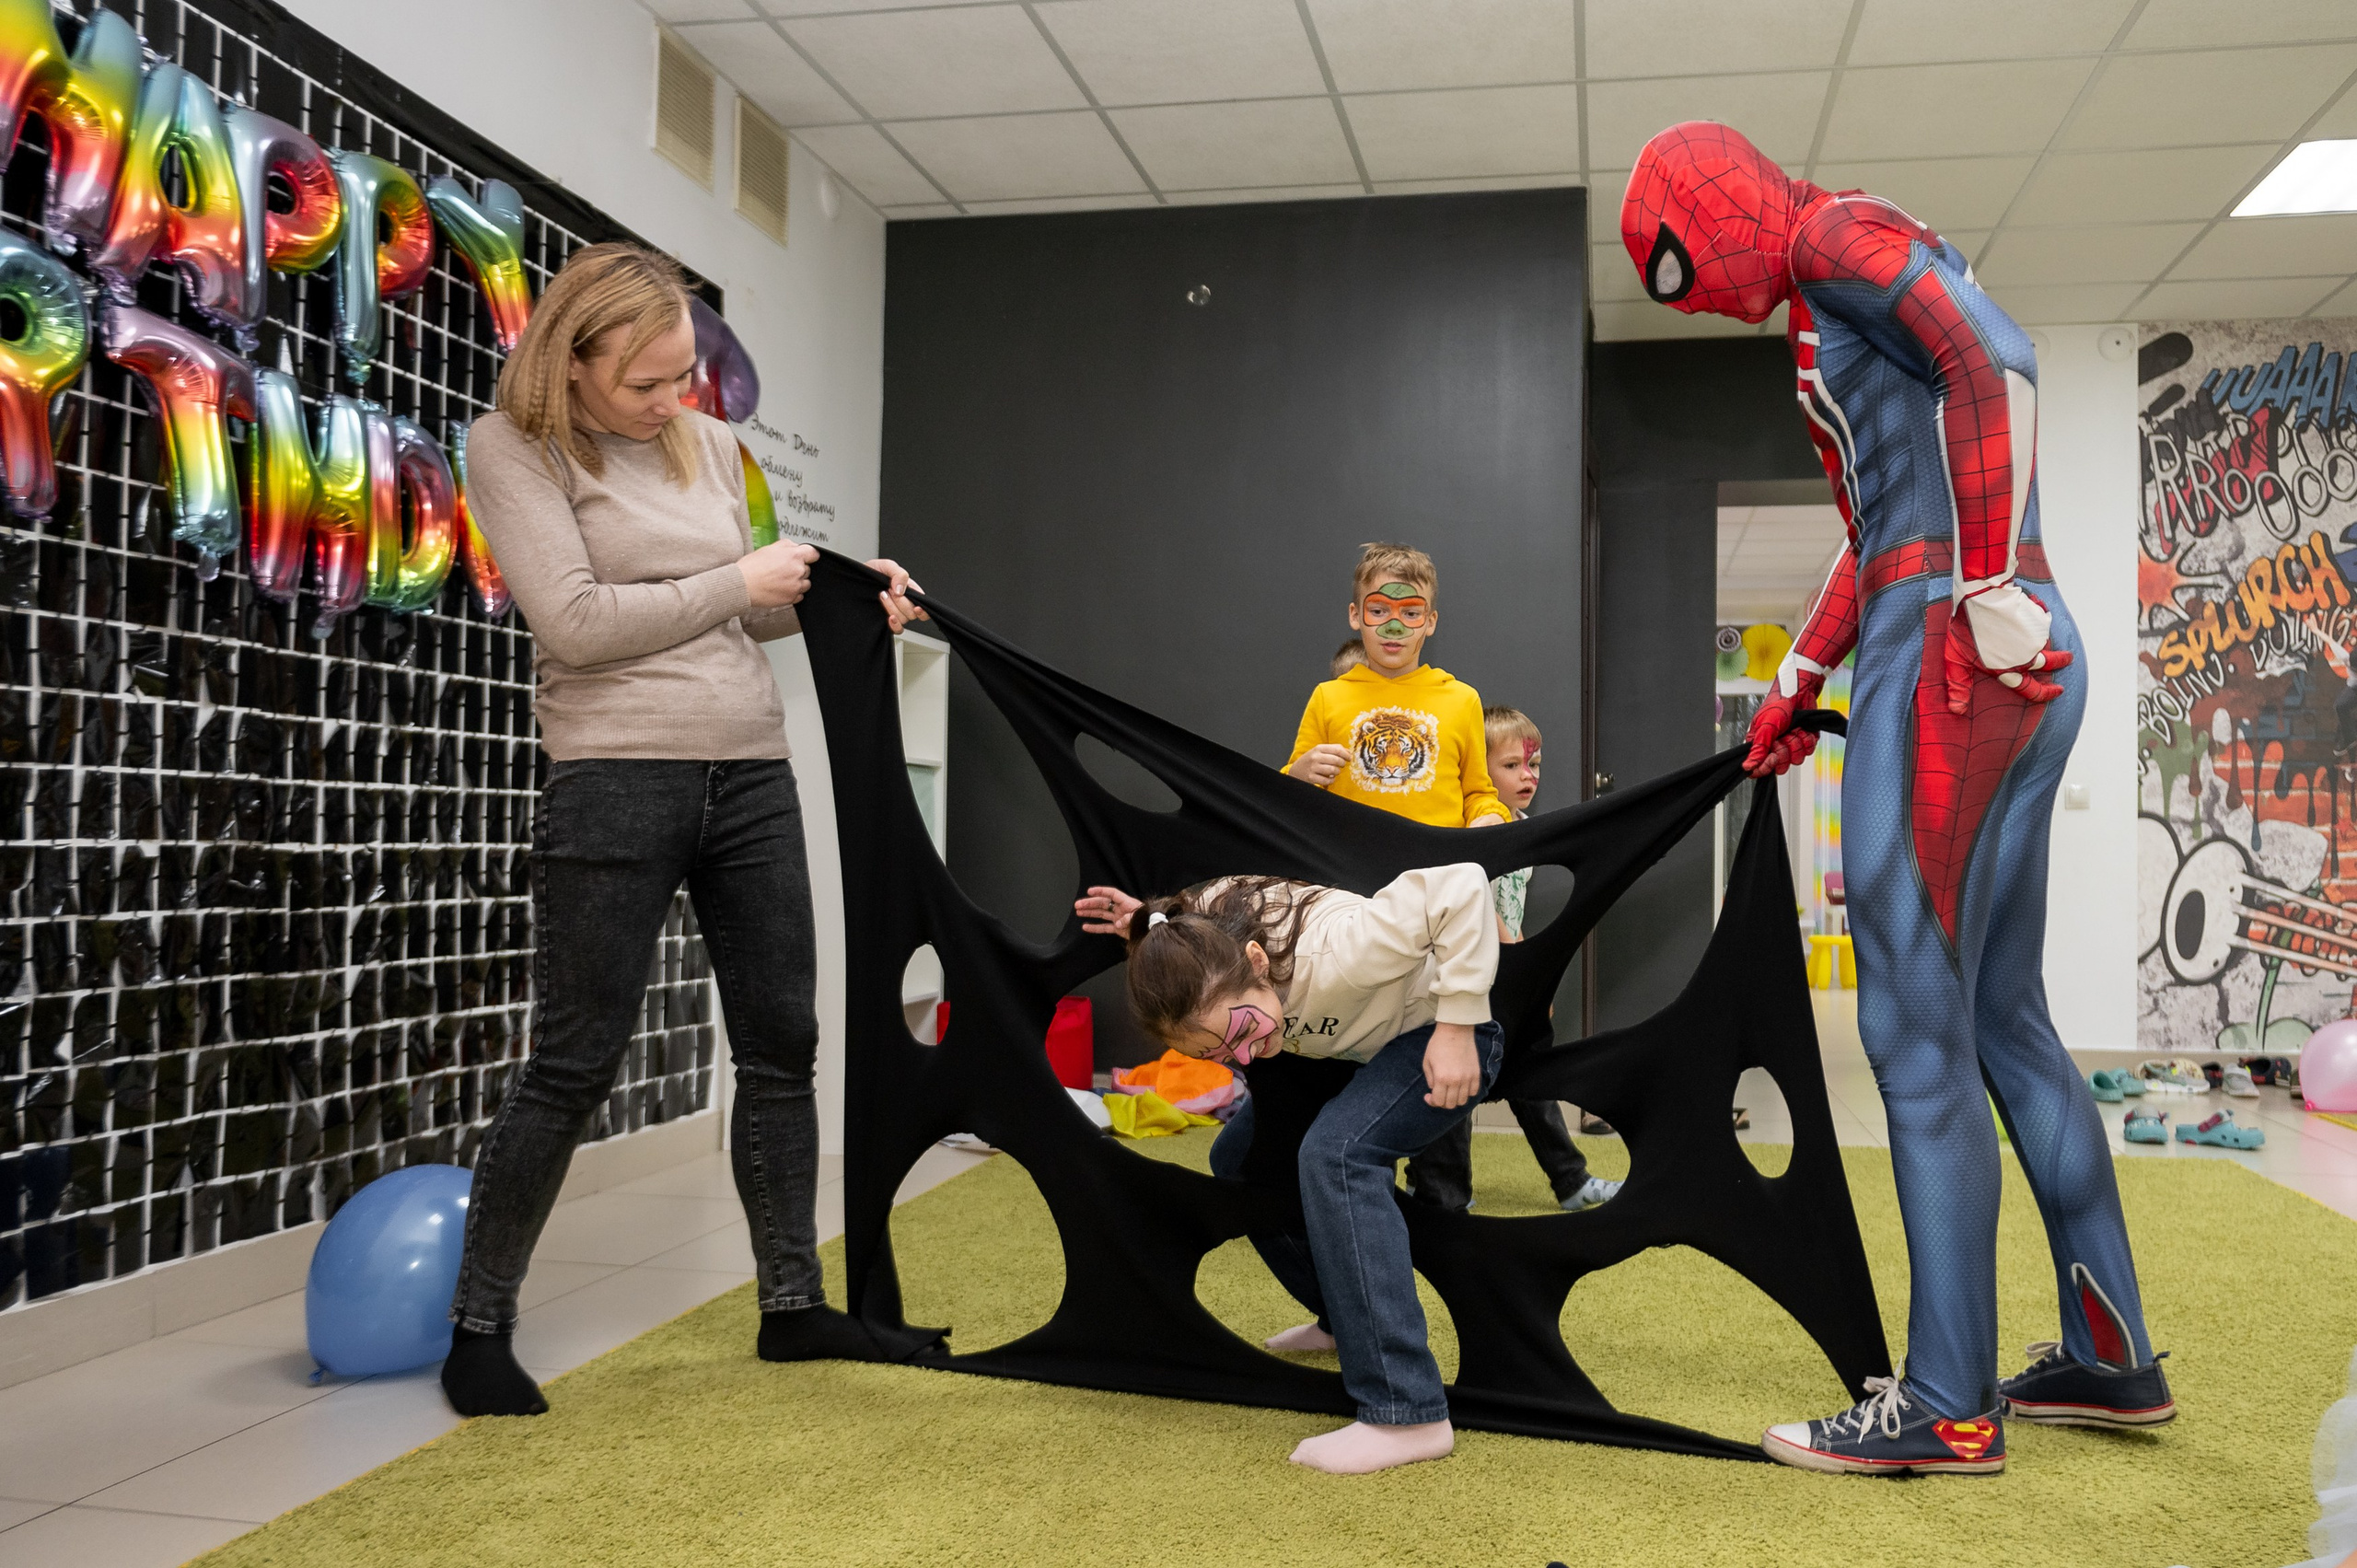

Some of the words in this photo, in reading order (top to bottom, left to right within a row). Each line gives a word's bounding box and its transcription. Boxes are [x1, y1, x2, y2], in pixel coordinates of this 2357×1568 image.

[750, 412, 787, 444] Этот
[761, 455, 803, 488] обмену
[774, 490, 783, 502] и
[788, 489, 836, 522] возврату
[778, 517, 830, 542] одлежит
[2158, 530, 2351, 678] SPLURCH
